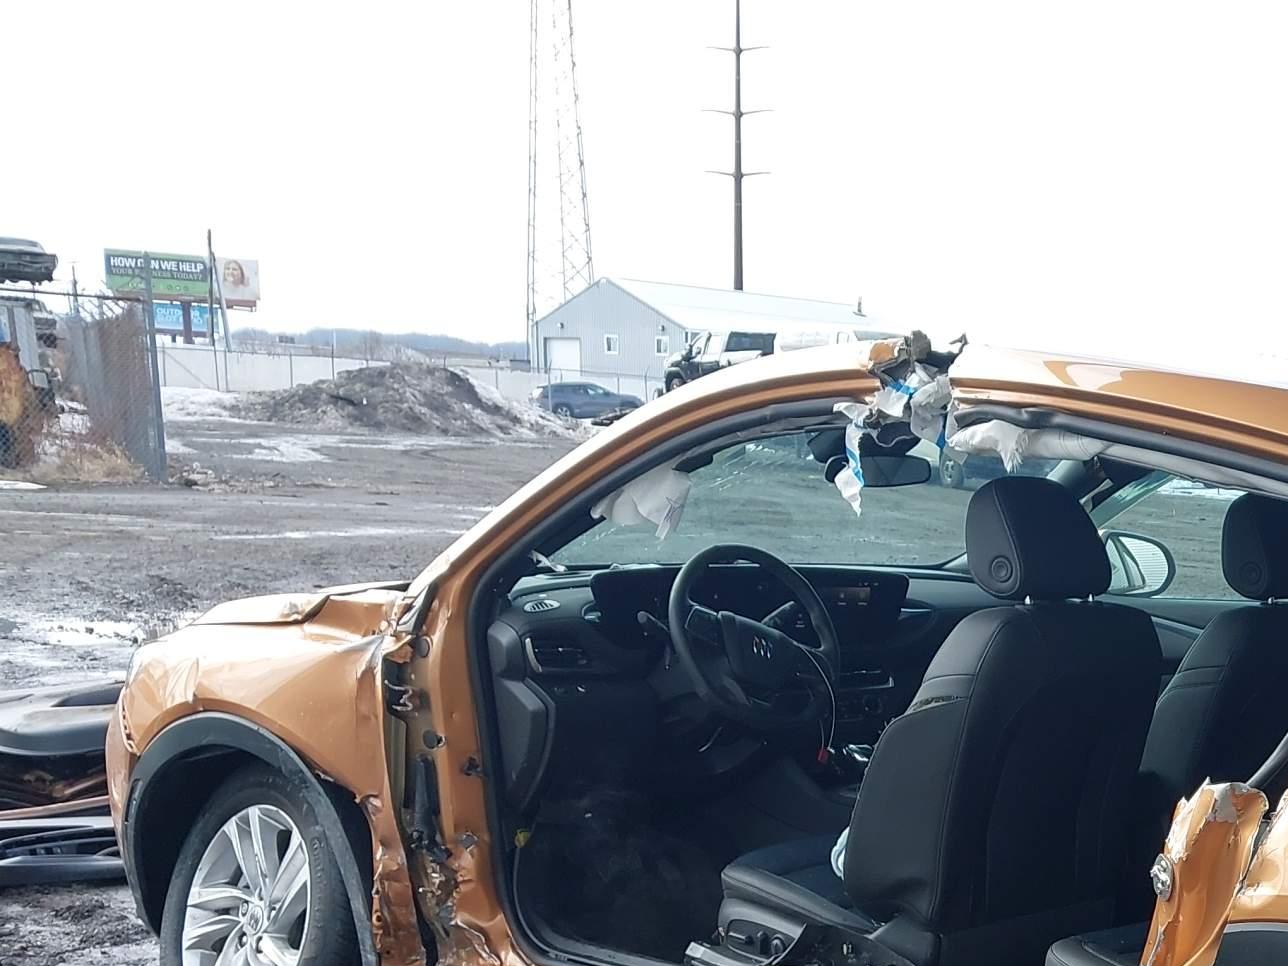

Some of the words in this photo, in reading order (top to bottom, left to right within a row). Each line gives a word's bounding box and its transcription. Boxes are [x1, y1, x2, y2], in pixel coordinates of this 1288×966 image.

[110, 255, 136, 268] HOW
[137, 258, 160, 270] CN
[160, 260, 178, 272] WE
[179, 262, 204, 273] HELP
[111, 267, 133, 275] YOUR
